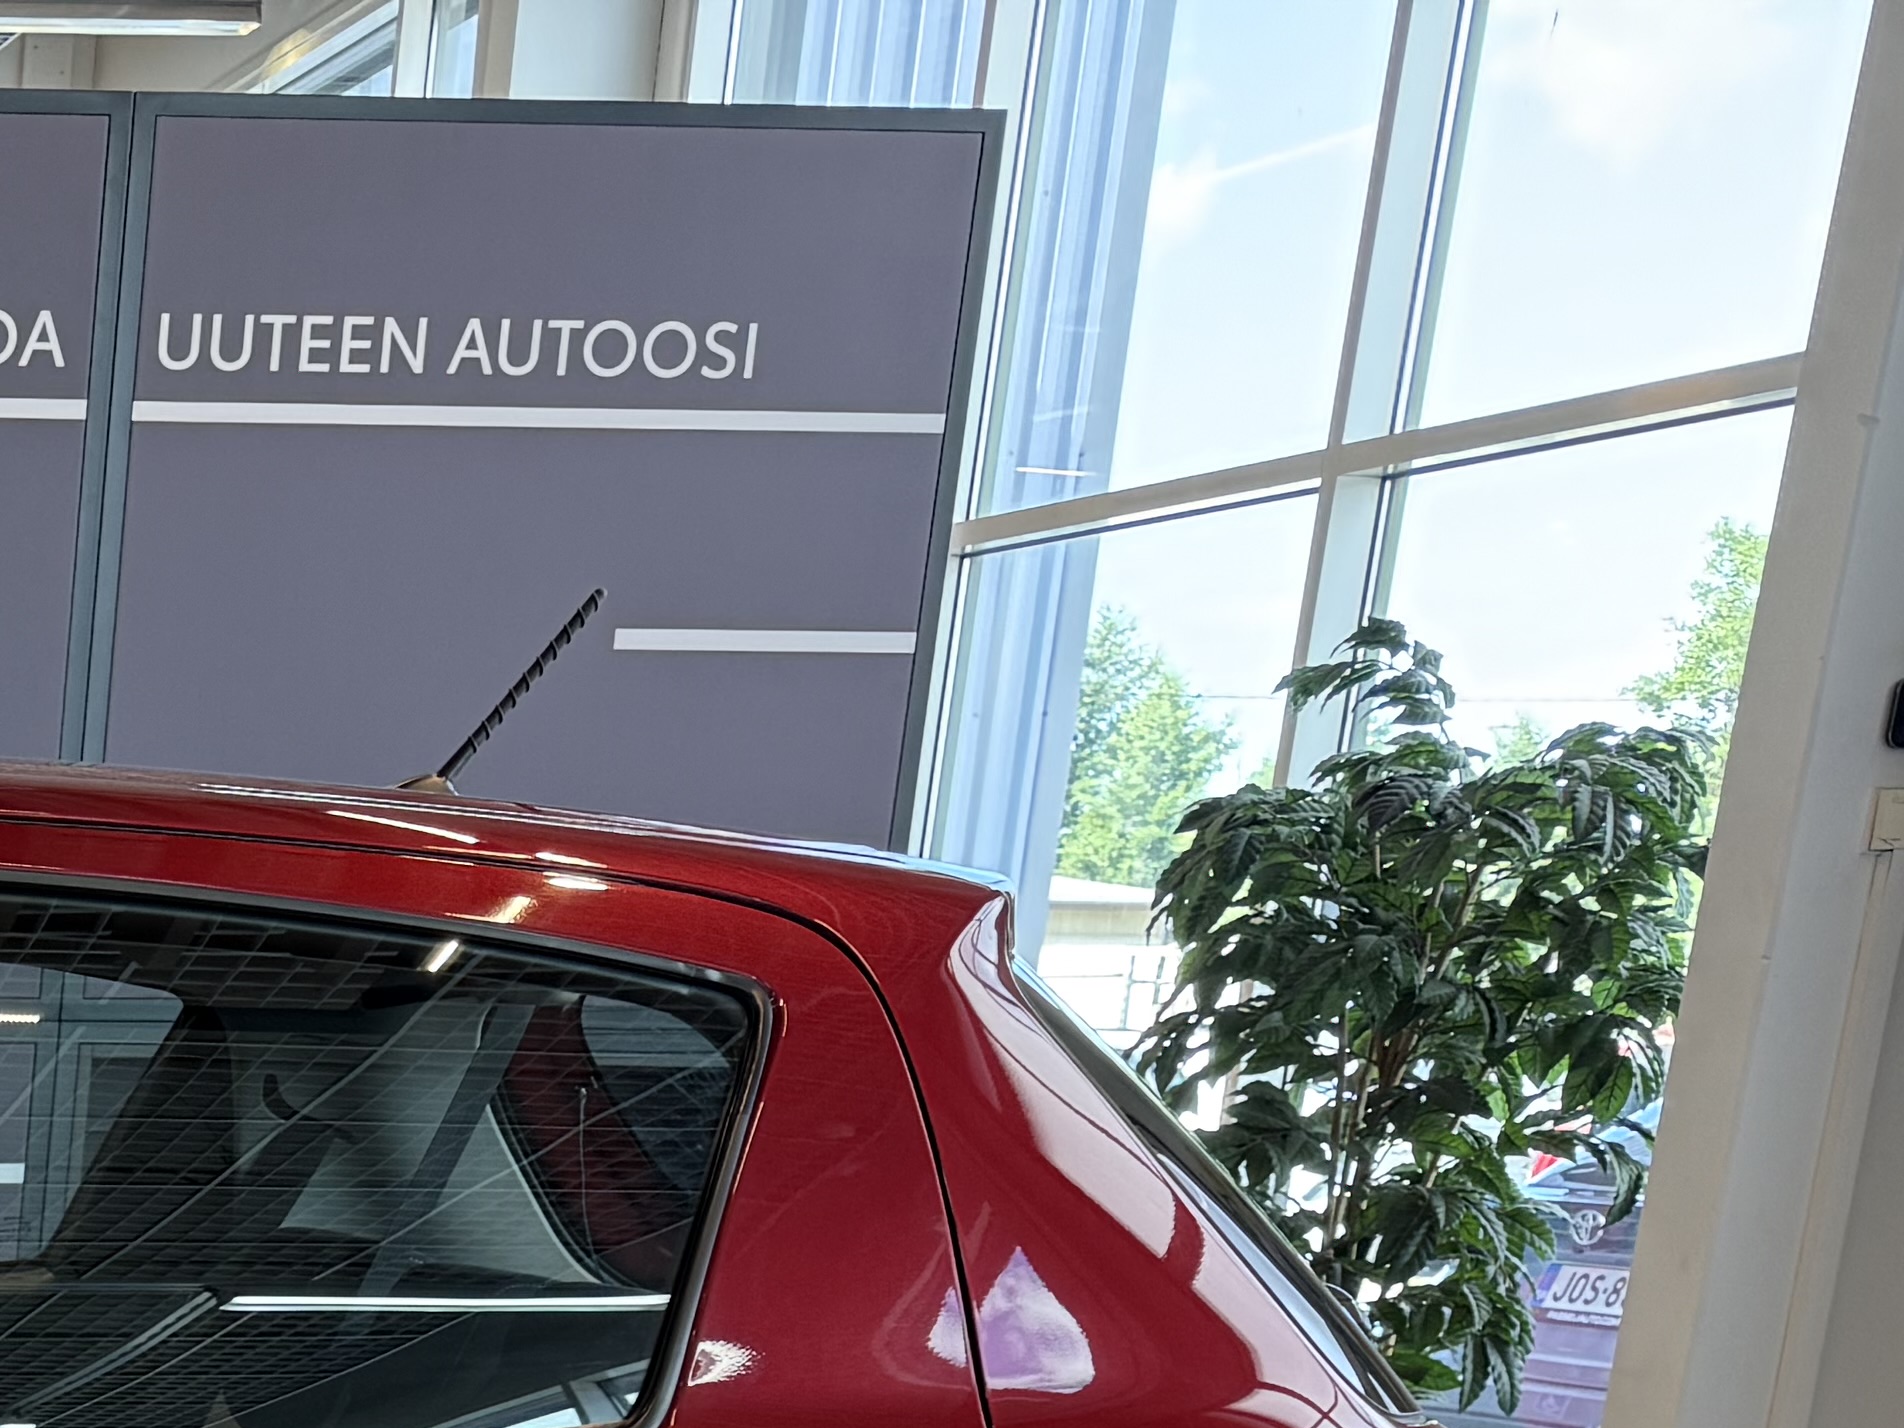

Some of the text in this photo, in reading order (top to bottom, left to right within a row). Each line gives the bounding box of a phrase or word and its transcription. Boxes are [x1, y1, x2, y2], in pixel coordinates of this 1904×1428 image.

[158, 313, 428, 374] UUTEEN
[446, 318, 758, 379] AUTOOSI
[1553, 1271, 1628, 1309] JOS-8
